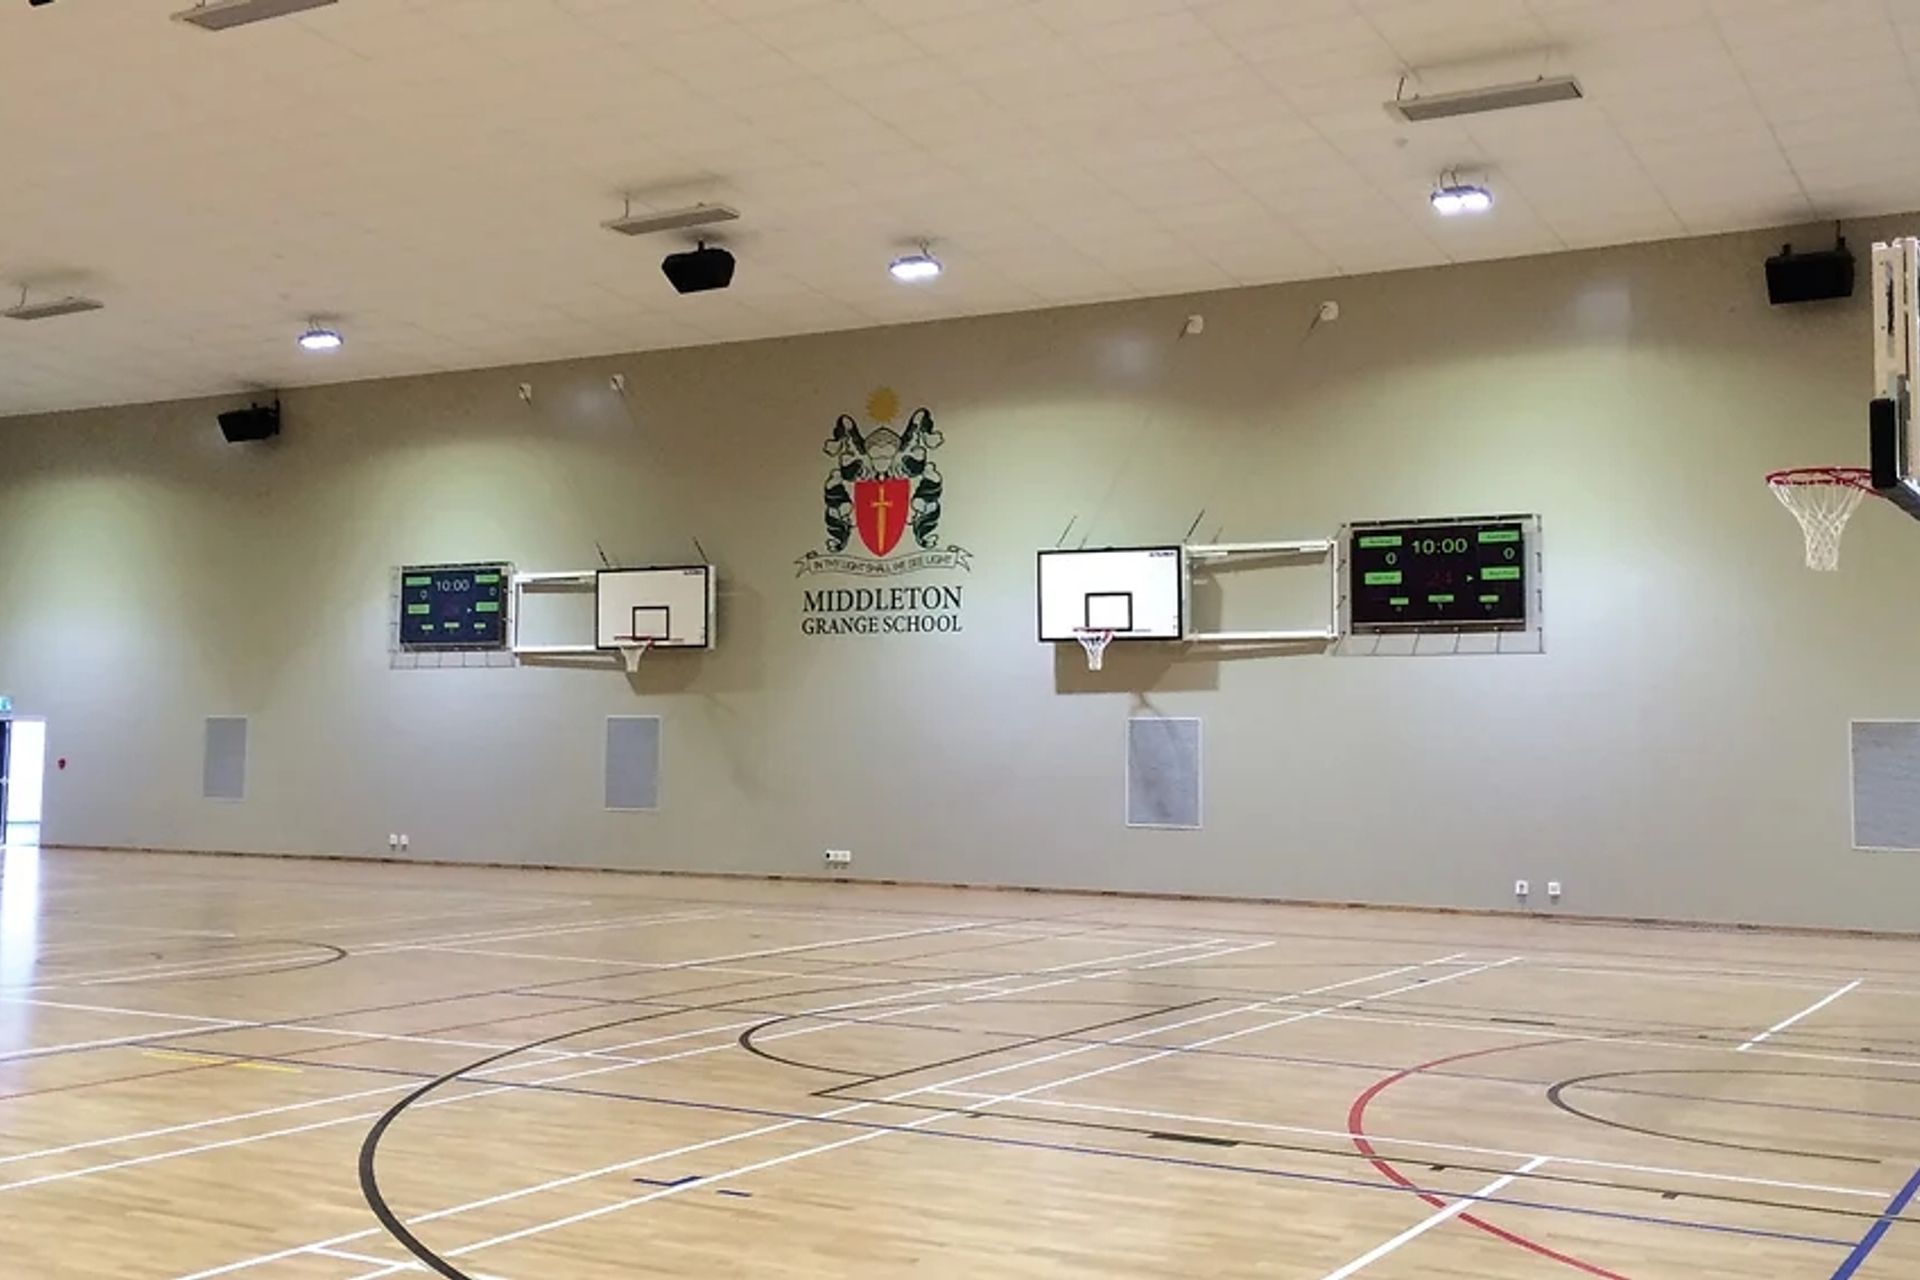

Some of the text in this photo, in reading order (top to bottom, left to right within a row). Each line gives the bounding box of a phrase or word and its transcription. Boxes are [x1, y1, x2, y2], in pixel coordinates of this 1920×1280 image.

[1411, 537, 1468, 555] 10:00
[436, 579, 471, 592] 10:00
[803, 586, 963, 613] MIDDLETON
[801, 615, 963, 636] GRANGE SCHOOL
